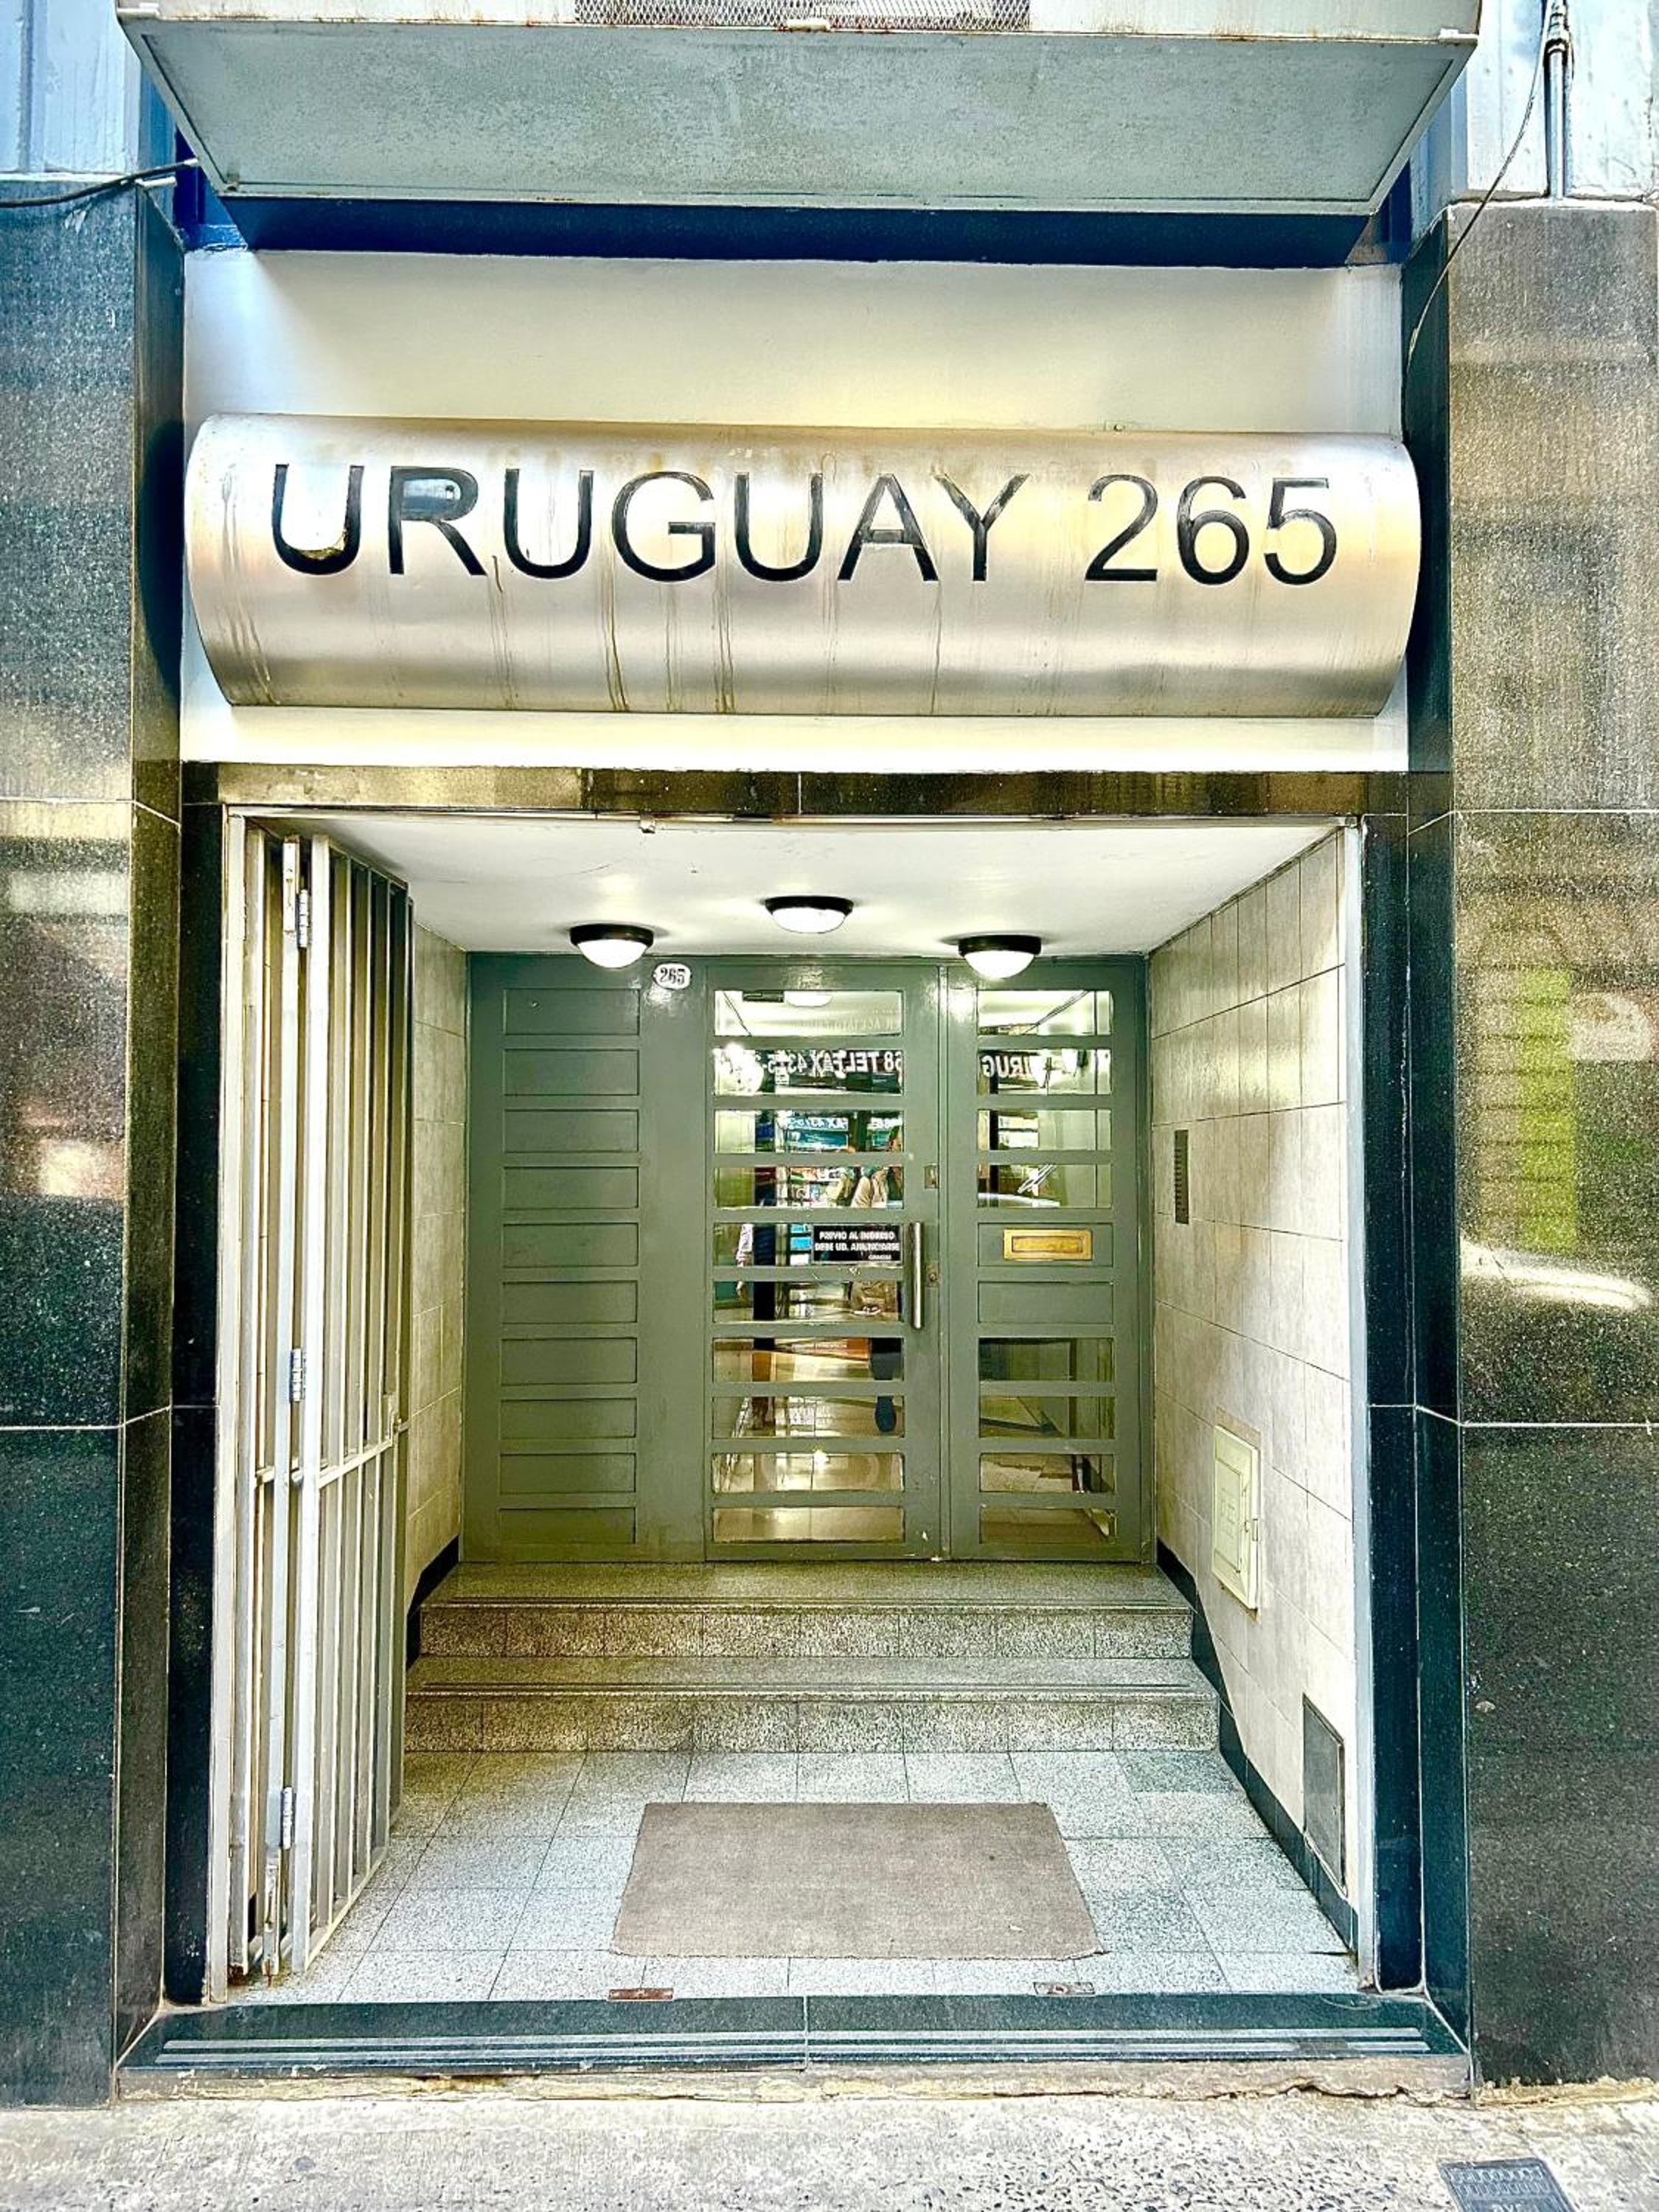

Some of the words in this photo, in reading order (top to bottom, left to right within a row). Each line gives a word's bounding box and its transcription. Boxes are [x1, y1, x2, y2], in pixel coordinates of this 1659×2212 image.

[272, 464, 1030, 582] URUGUAY
[1085, 473, 1337, 585] 265
[660, 967, 686, 985] 265
[849, 1231, 859, 1239] AL
[815, 1242, 834, 1251] DEBE
[850, 1242, 900, 1251] ANUNCIARSE
